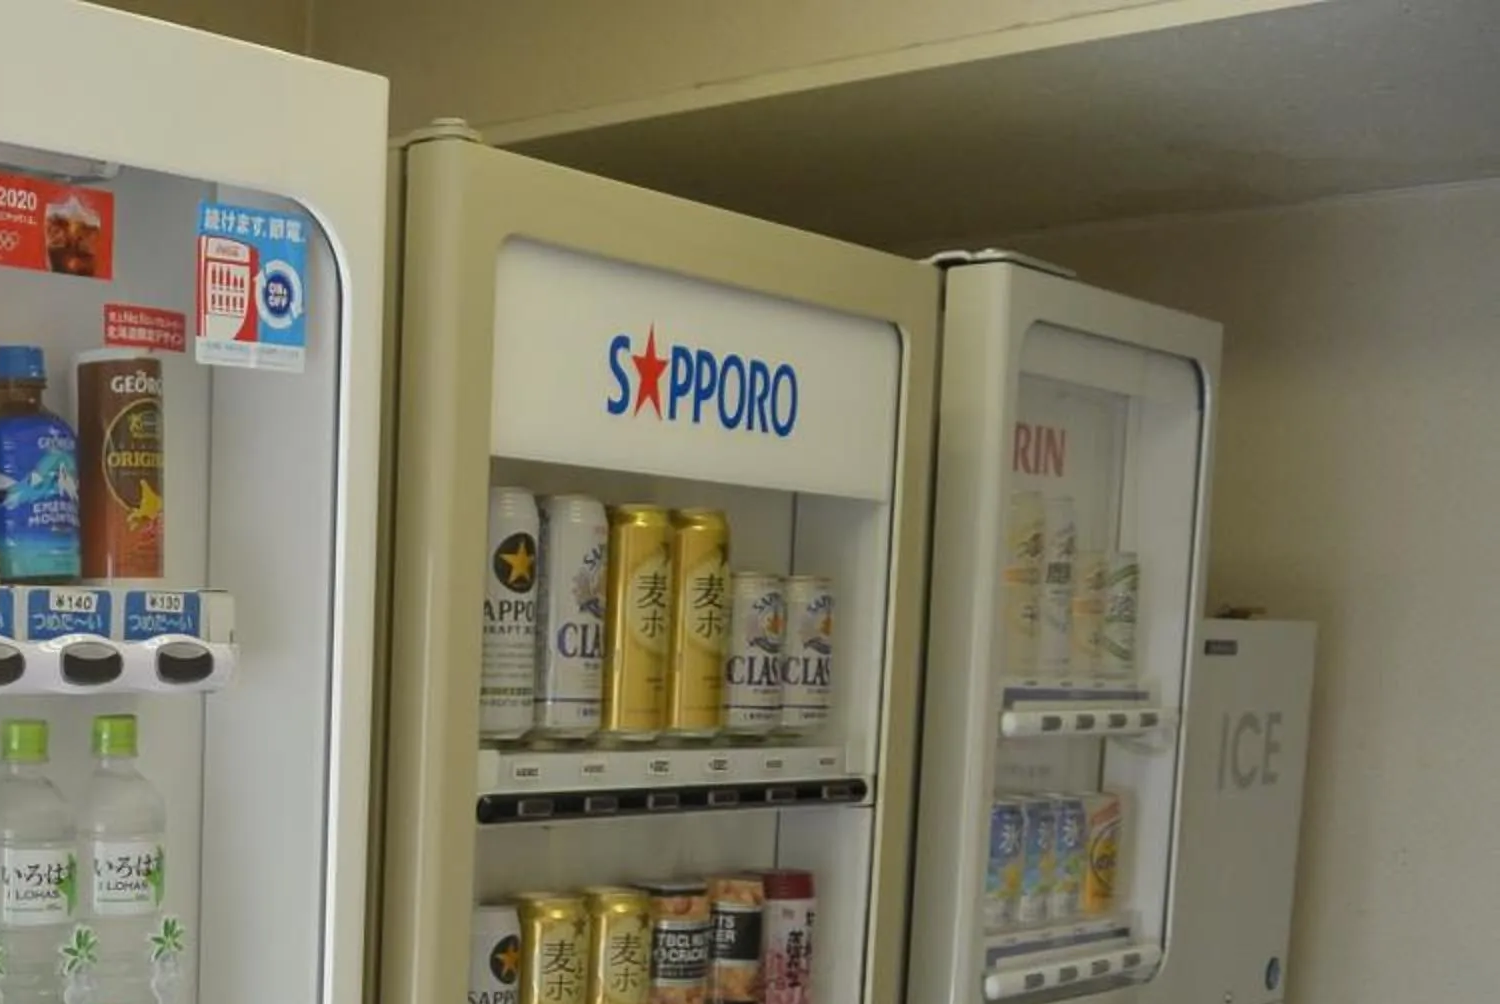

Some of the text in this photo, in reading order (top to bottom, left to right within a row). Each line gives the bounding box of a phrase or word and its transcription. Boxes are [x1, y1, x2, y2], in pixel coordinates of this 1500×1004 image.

[1013, 421, 1066, 478] RIN
[55, 593, 92, 609] ¥140
[483, 600, 535, 622] APPO
[1217, 711, 1283, 794] ICE
